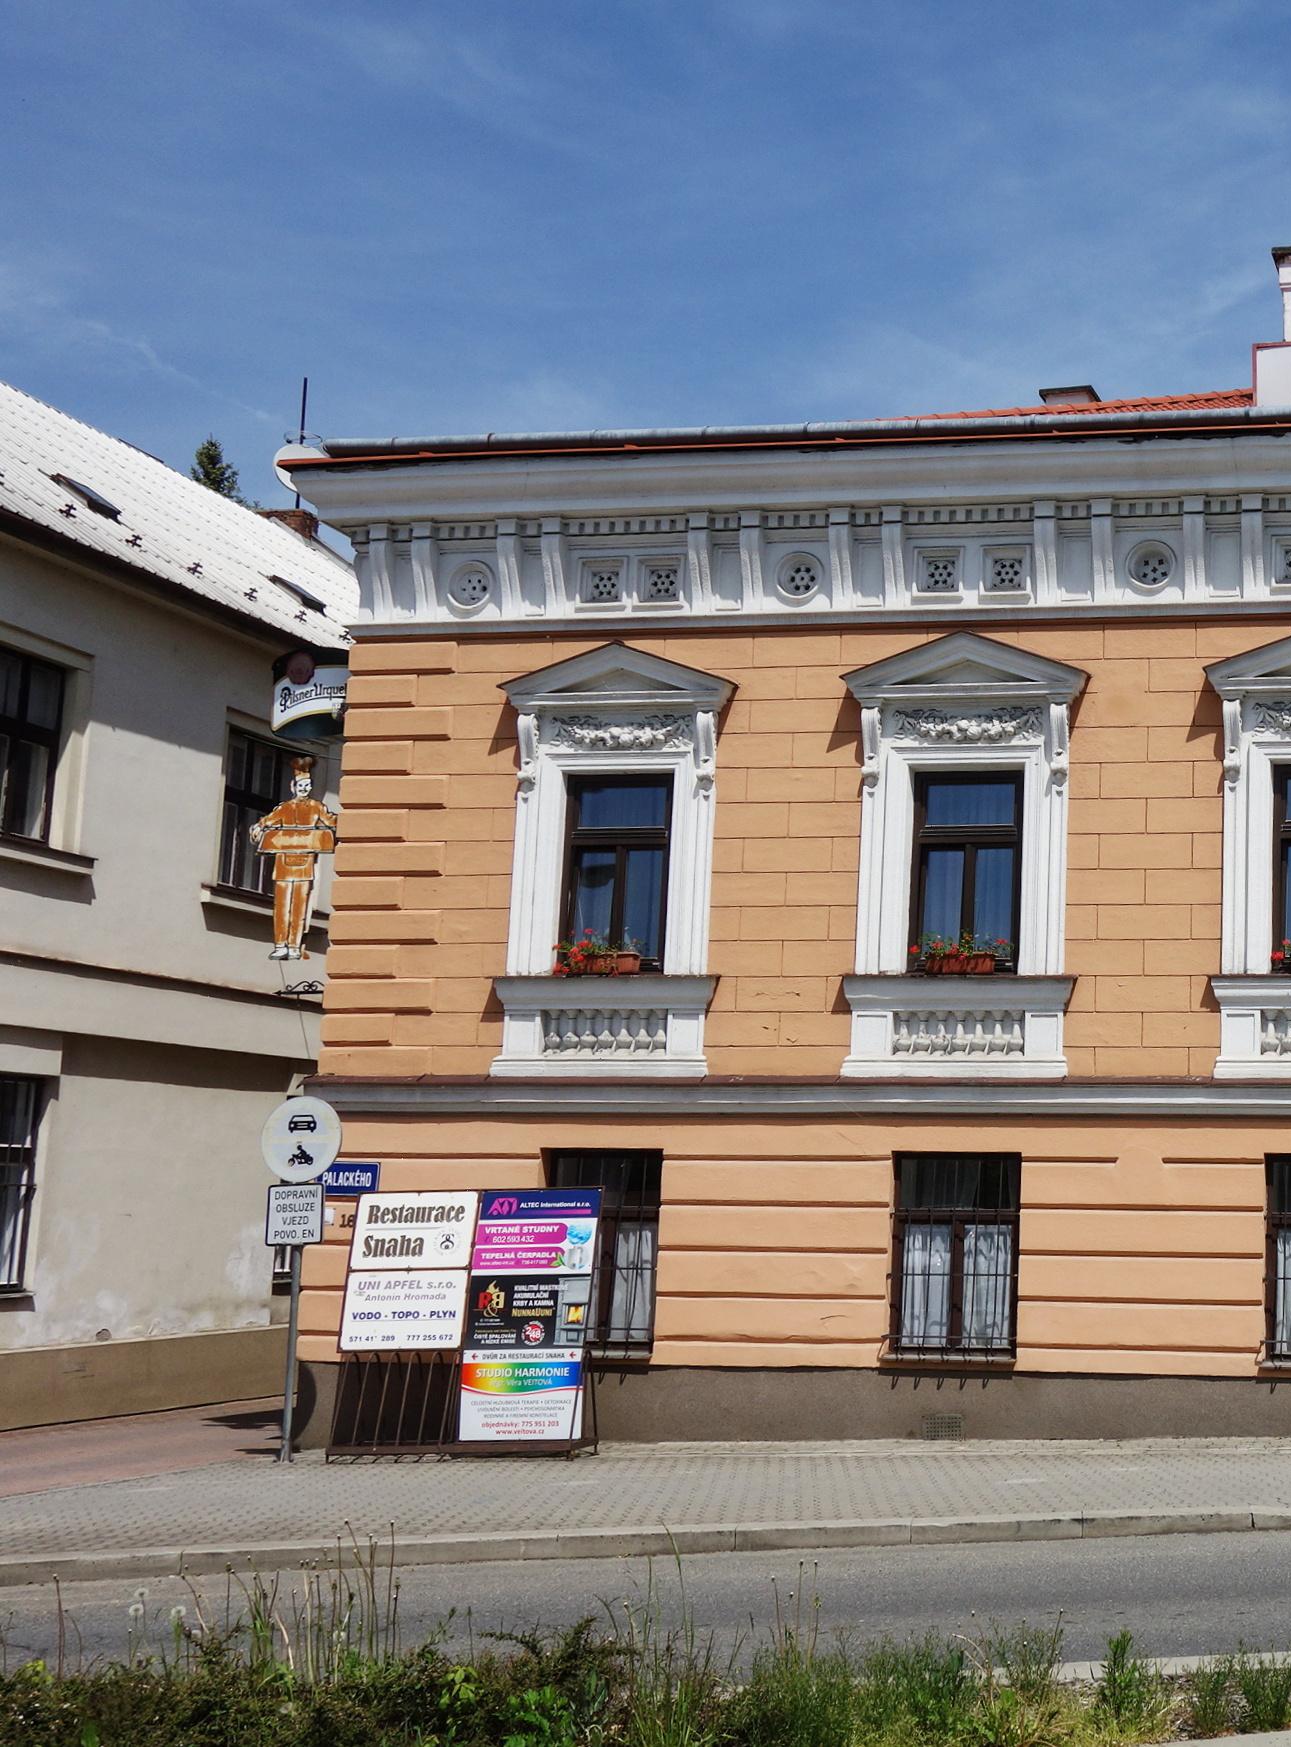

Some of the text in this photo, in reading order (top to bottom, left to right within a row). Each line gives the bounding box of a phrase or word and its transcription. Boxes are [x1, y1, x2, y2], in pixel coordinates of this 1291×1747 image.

[279, 683, 347, 713] Pilsner Urquel
[322, 1170, 372, 1187] PALACKÉHO
[275, 1187, 318, 1200] DOPRAVNÍ
[276, 1202, 315, 1213] OBSLUZE
[366, 1204, 465, 1224] Restaurace
[282, 1215, 309, 1226] VJEZD
[485, 1225, 560, 1234] VRTANÉ STUDNY
[362, 1234, 424, 1258] Snaha
[358, 1280, 456, 1291] UNI APFEL s.r.o.
[404, 1292, 446, 1301] Hromada
[352, 1312, 382, 1320] VODO
[391, 1311, 420, 1319] TOPO
[429, 1310, 456, 1318] PLYN
[475, 1367, 570, 1377] STUDIO HARMONIE
